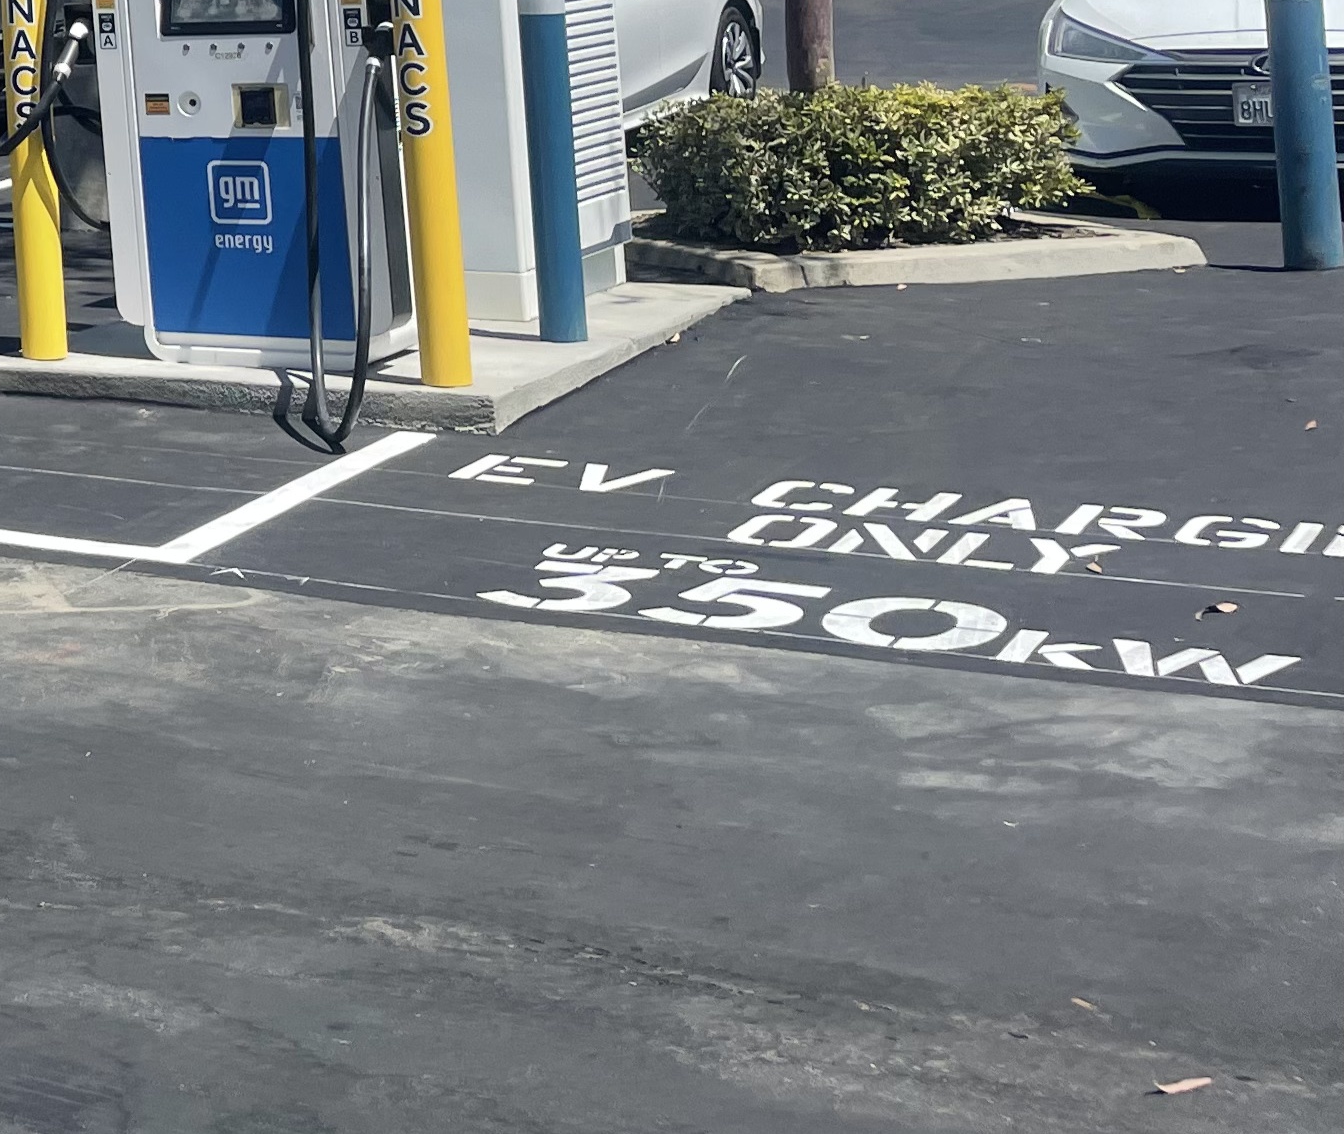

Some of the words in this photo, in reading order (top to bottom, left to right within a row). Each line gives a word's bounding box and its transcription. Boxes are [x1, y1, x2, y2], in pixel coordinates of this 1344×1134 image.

[103, 35, 114, 47] A
[349, 30, 360, 44] B
[219, 176, 261, 209] gm
[215, 233, 273, 254] energy
[448, 453, 676, 492] EV
[750, 479, 1344, 557] CHARGI
[542, 543, 640, 562] UP
[660, 552, 759, 575] TO
[727, 514, 1121, 574] ONLY
[475, 560, 1302, 686] 350kW
